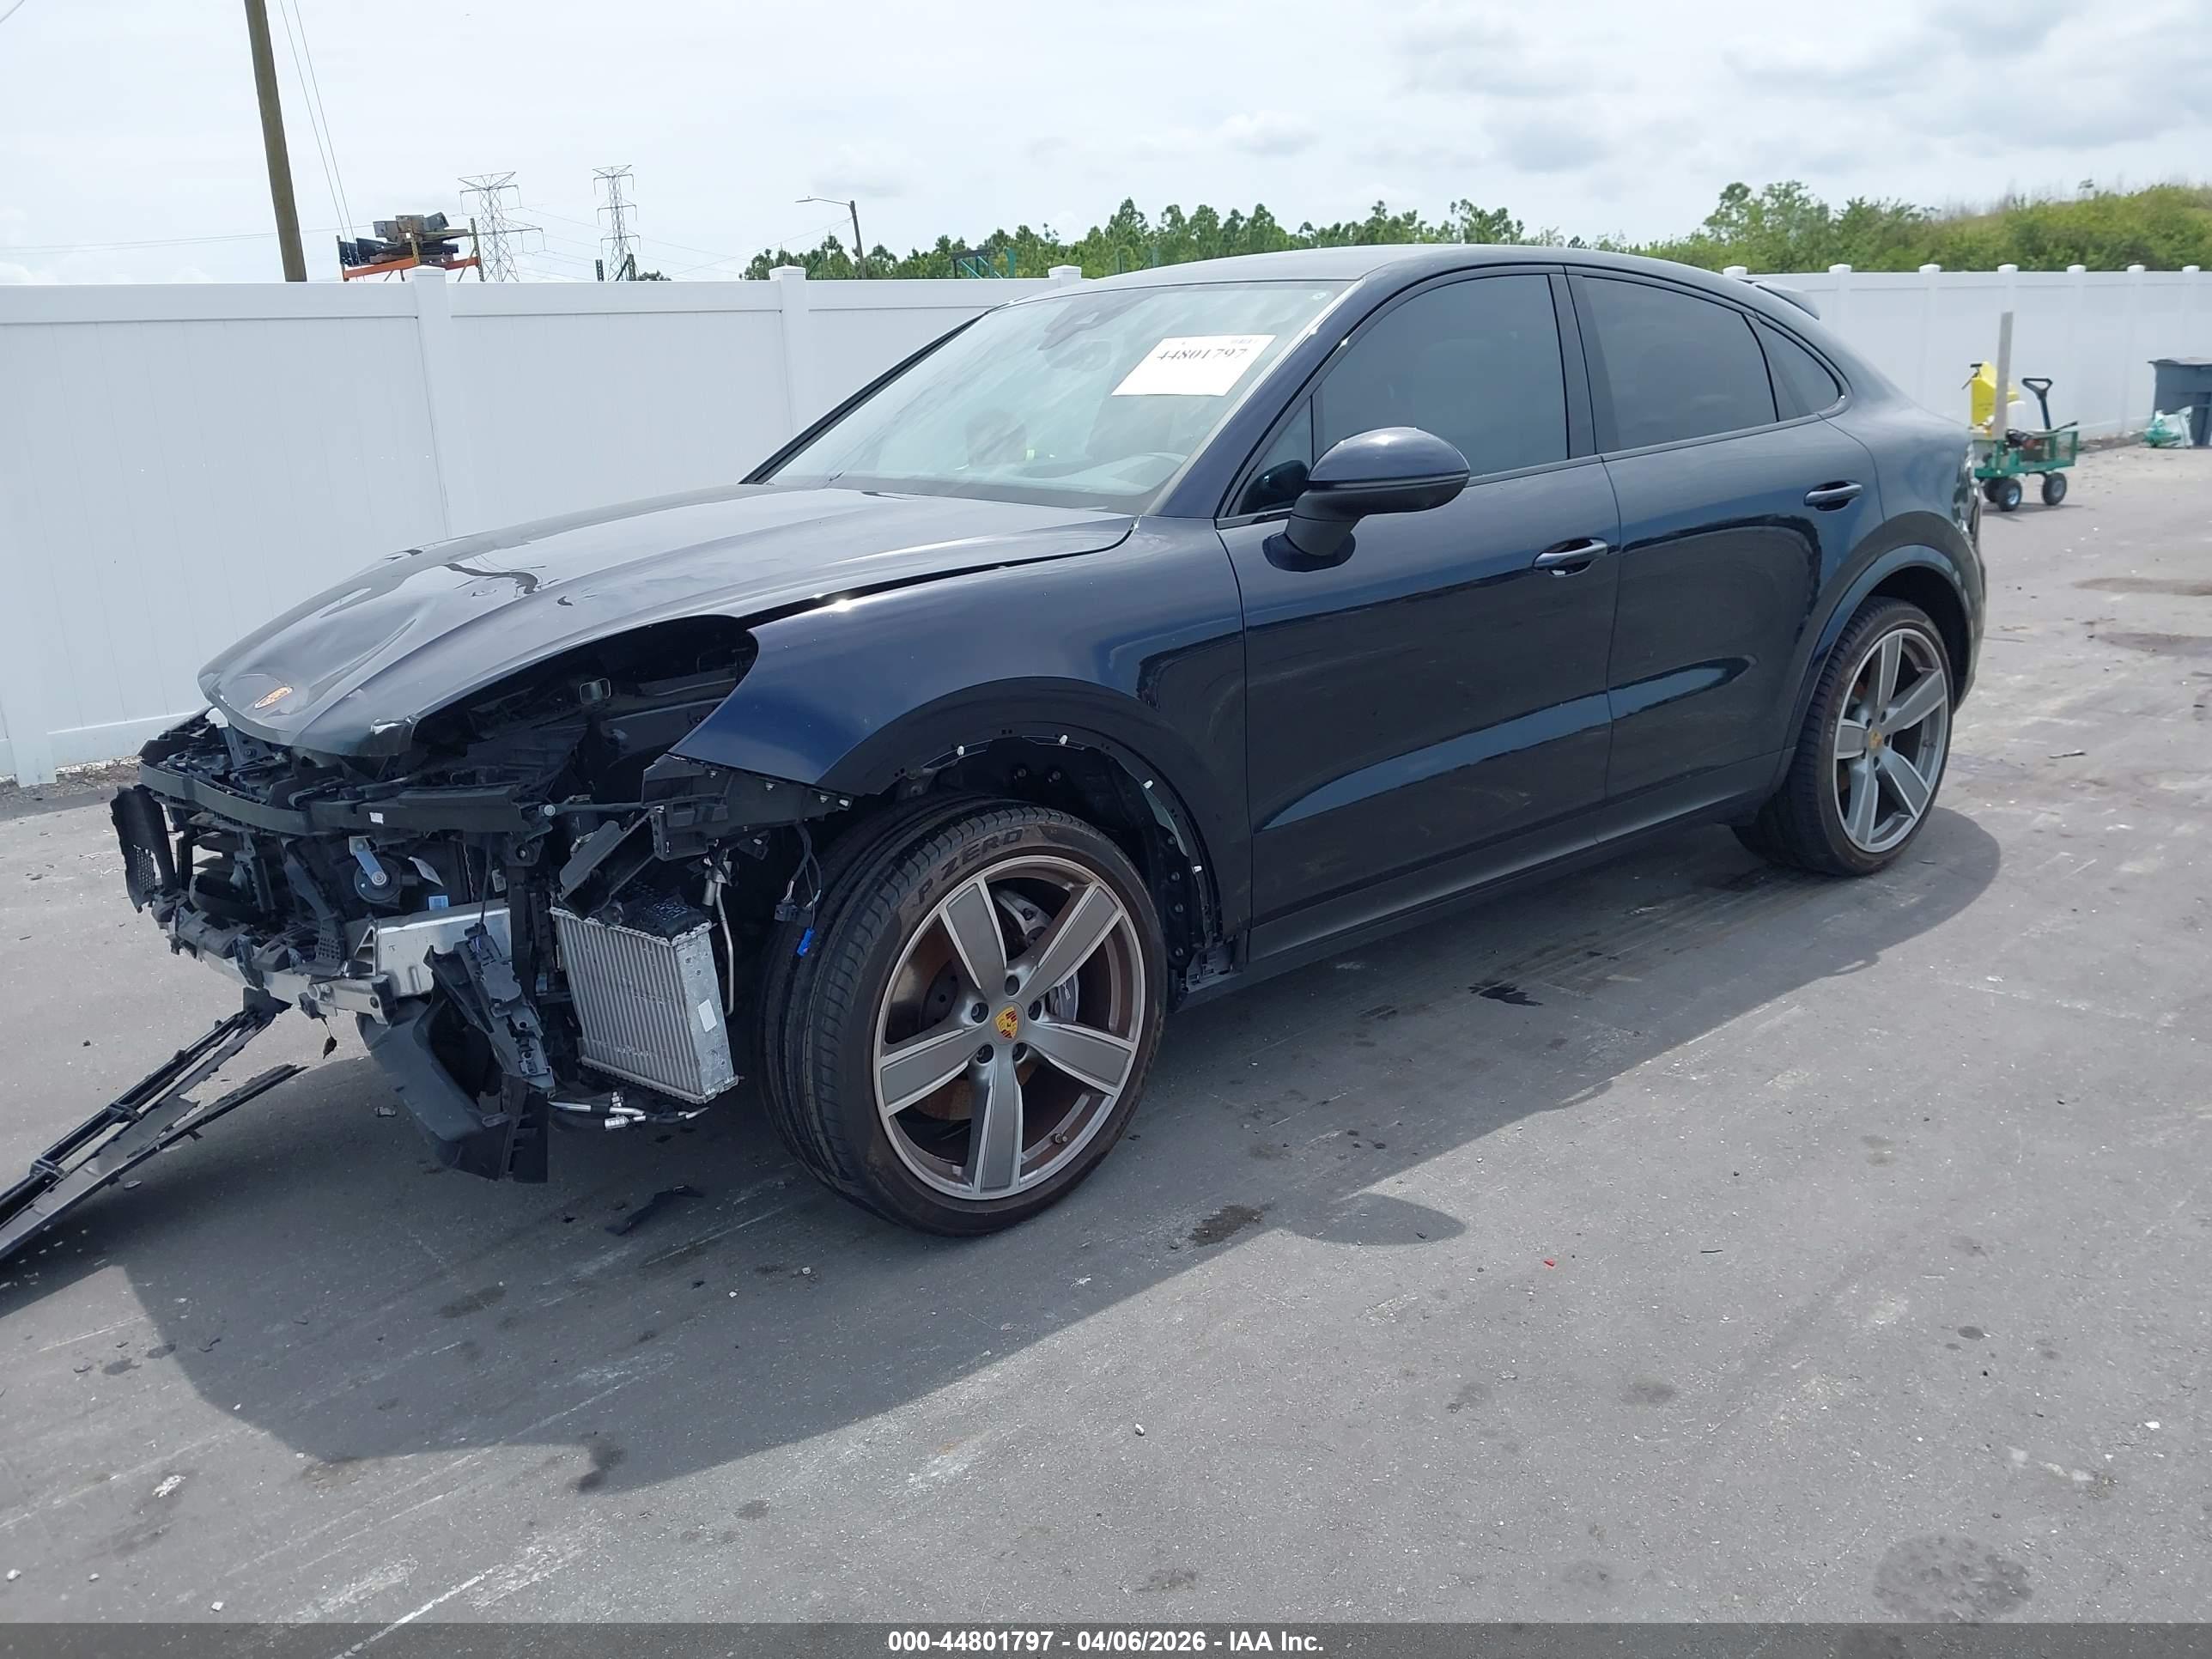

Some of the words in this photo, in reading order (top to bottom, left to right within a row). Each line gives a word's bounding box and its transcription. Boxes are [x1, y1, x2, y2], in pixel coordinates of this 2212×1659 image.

[1158, 349, 1248, 361] 44801797
[918, 878, 933, 904] P
[941, 829, 1024, 881] ZERO
